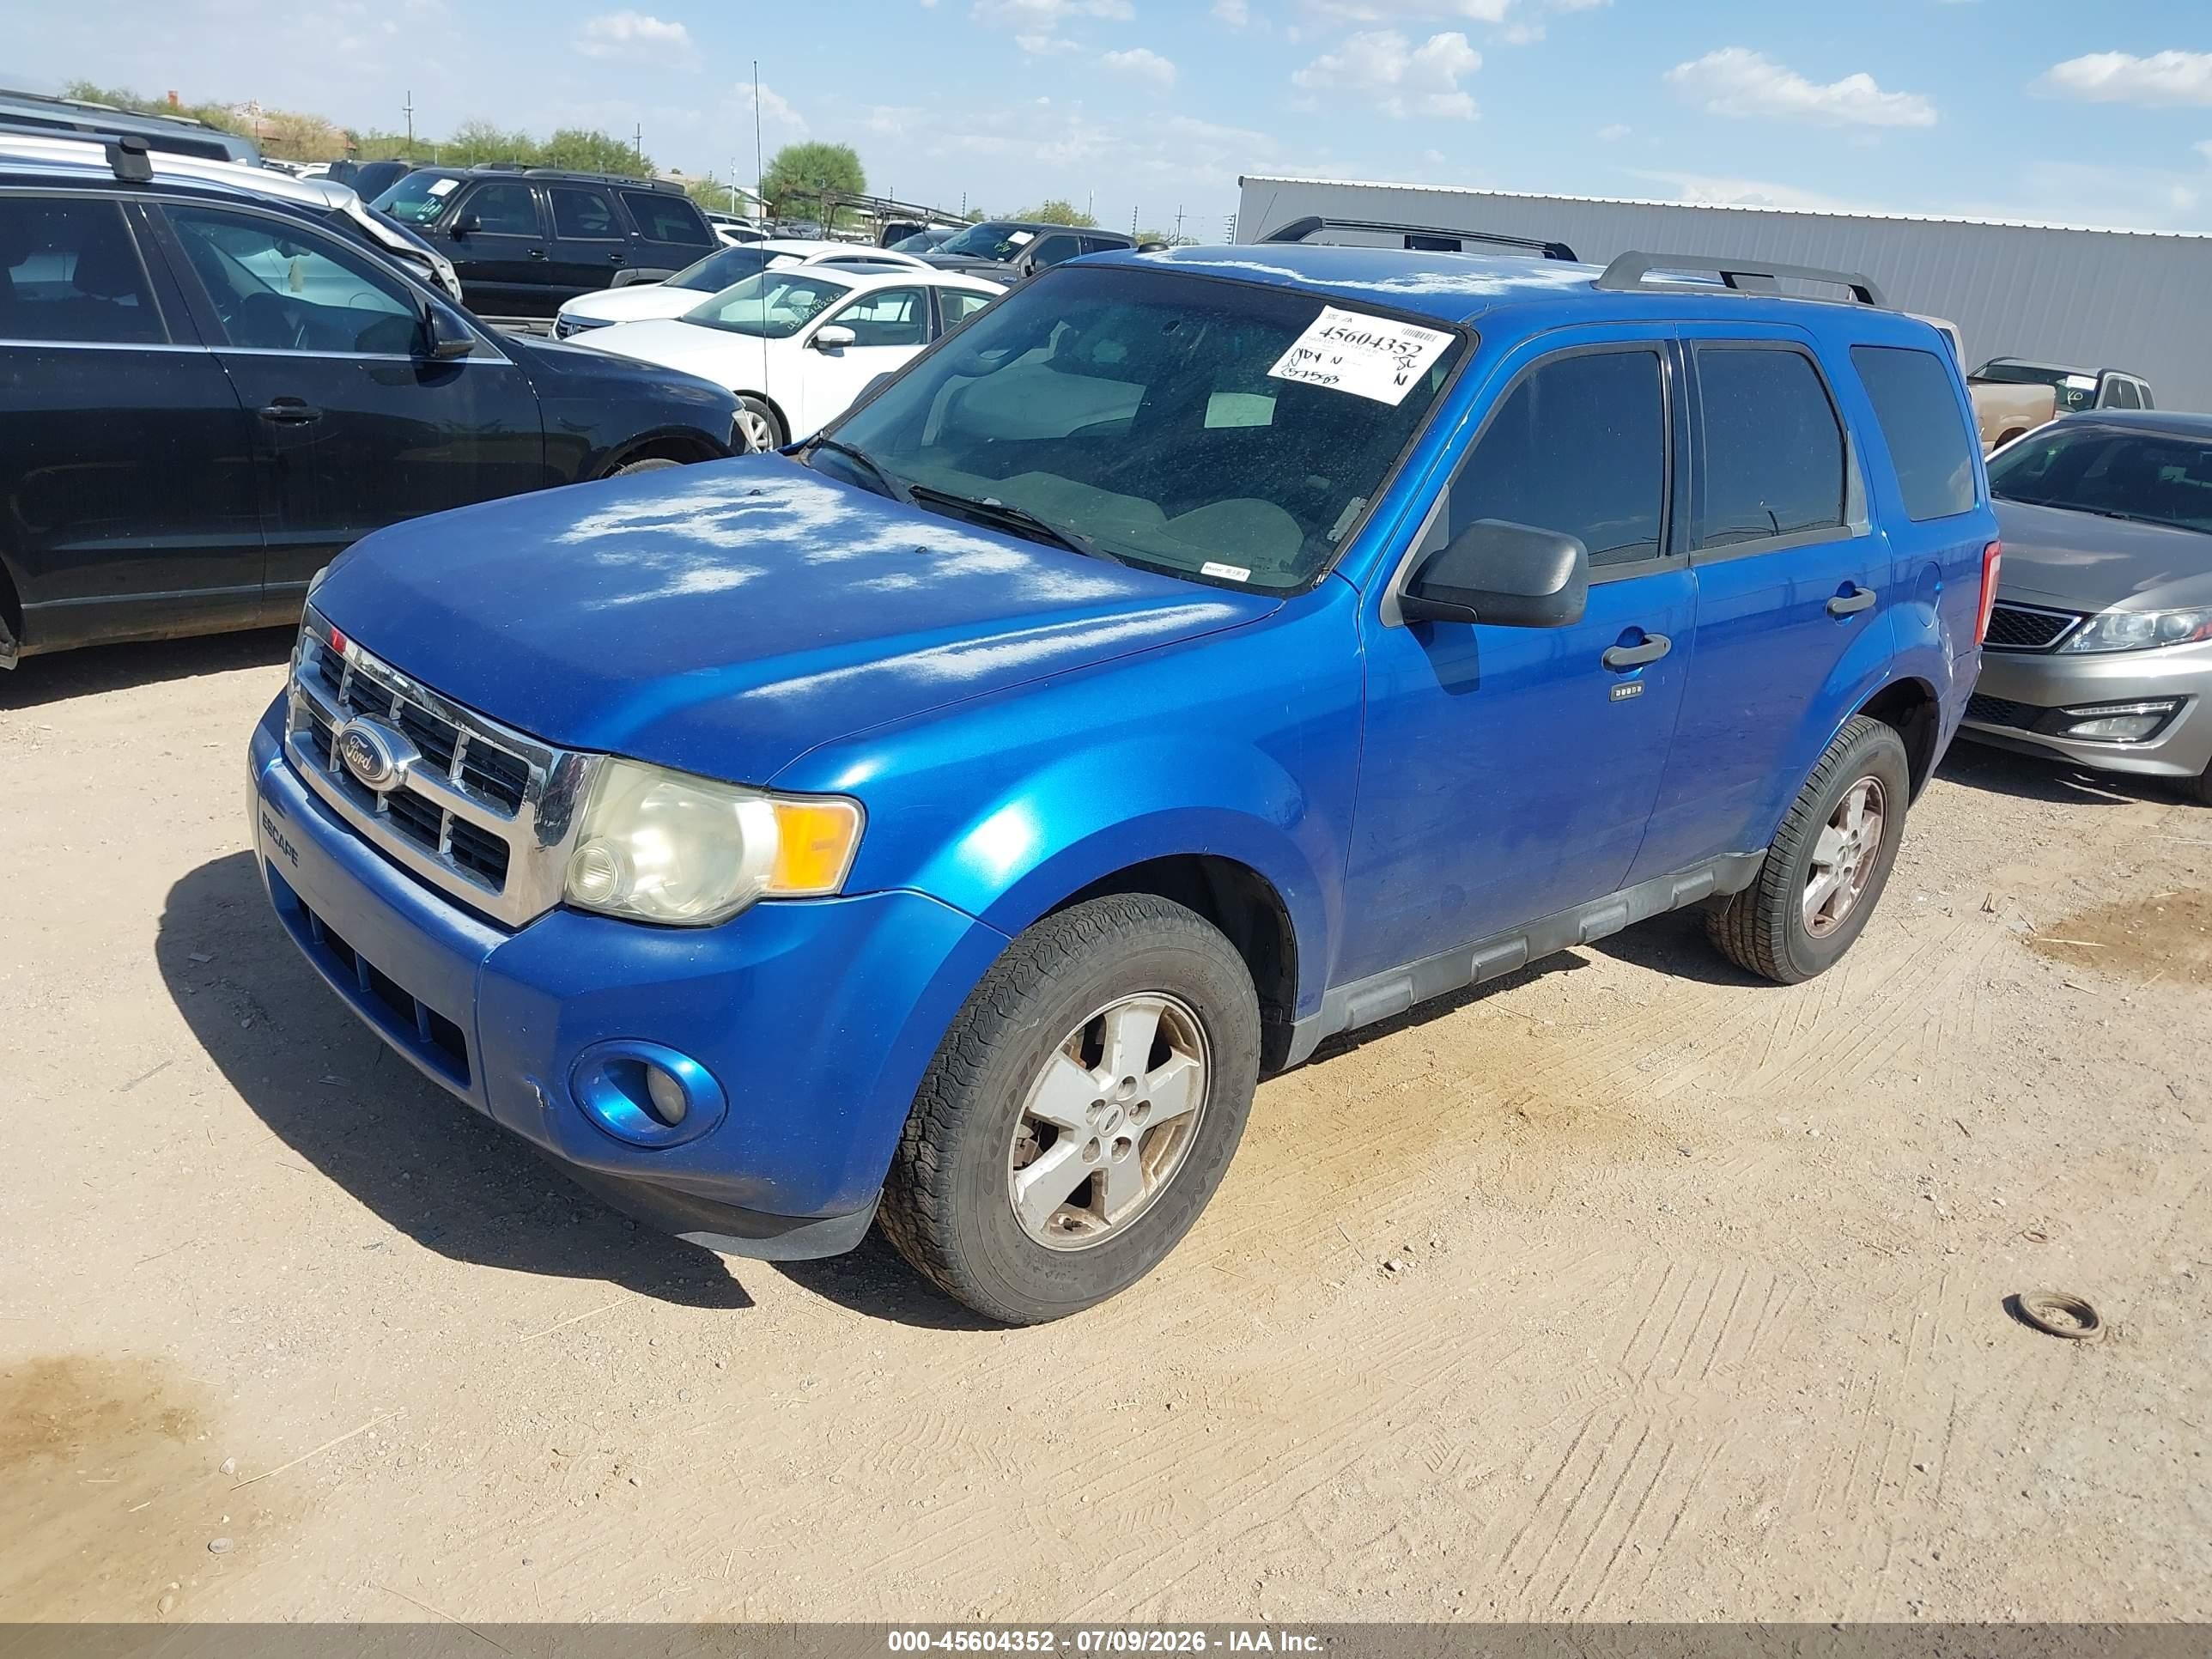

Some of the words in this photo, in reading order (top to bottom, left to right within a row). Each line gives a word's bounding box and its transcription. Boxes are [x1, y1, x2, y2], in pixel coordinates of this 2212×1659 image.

[1320, 326, 1423, 358] 45604352
[1393, 373, 1408, 386] N
[346, 736, 374, 771] Ford
[262, 811, 299, 868] ESCAPE
[1089, 1075, 1244, 1288] WRANGLE
